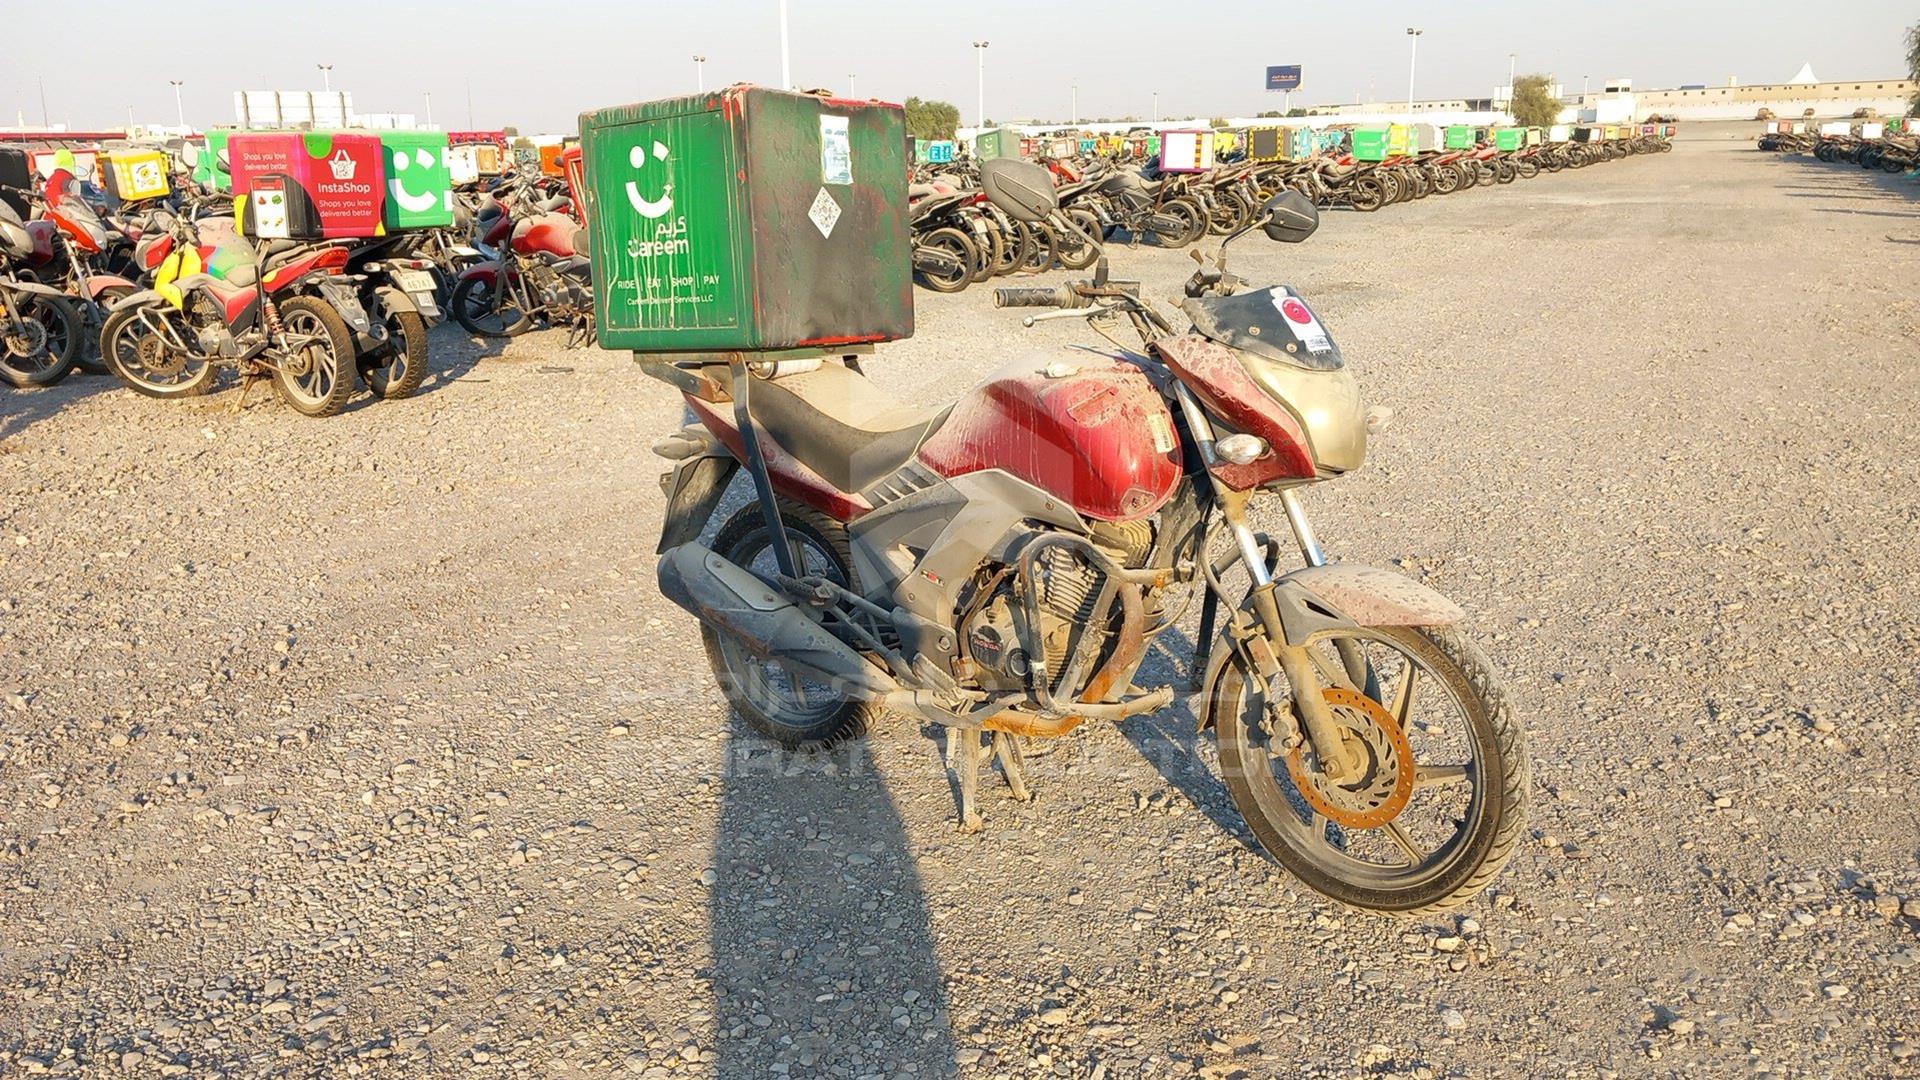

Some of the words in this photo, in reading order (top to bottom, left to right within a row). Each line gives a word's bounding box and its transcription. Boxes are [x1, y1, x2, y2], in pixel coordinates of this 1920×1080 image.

[243, 153, 261, 161] Shops
[262, 153, 273, 161] you
[273, 152, 287, 160] love
[244, 163, 269, 171] delivered
[318, 182, 371, 194] InstaShop
[319, 200, 341, 208] Shops
[342, 200, 356, 208] you
[357, 199, 372, 207] love
[320, 210, 351, 218] delivered
[656, 216, 687, 239] كريم
[627, 238, 690, 258] Careem
[617, 280, 636, 290] RIDE
[647, 278, 662, 288] EAT
[671, 277, 694, 287] SHOP
[703, 275, 720, 285] PAY
[674, 295, 700, 304] Services
[701, 294, 714, 303] LLC
[974, 639, 1000, 652] HONDA
